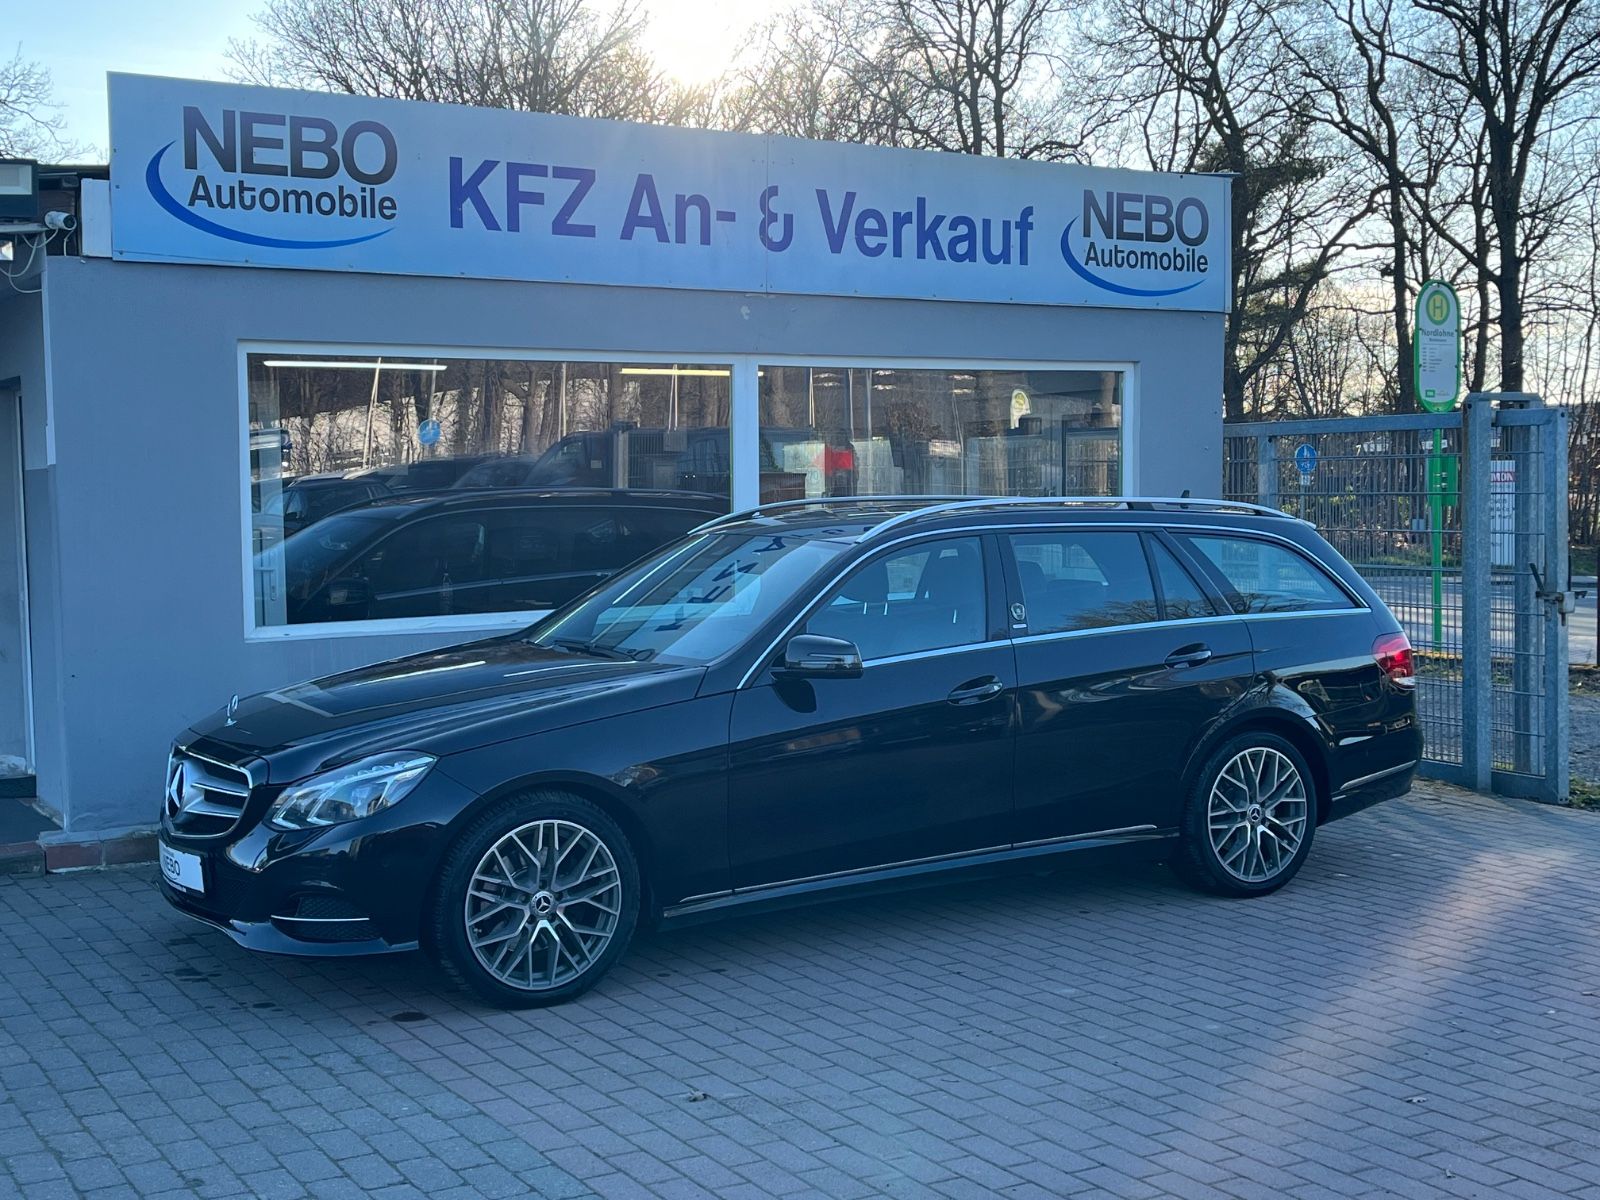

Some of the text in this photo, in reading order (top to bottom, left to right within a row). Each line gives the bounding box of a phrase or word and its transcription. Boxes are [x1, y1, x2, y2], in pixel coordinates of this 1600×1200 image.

[183, 106, 397, 185] NEBO
[188, 175, 397, 219] Automobile
[449, 157, 1033, 265] KFZ An- & Verkauf
[1083, 189, 1209, 246] NEBO
[1084, 241, 1208, 273] Automobile
[1432, 298, 1443, 318] H
[1421, 328, 1455, 337] Nordlohne
